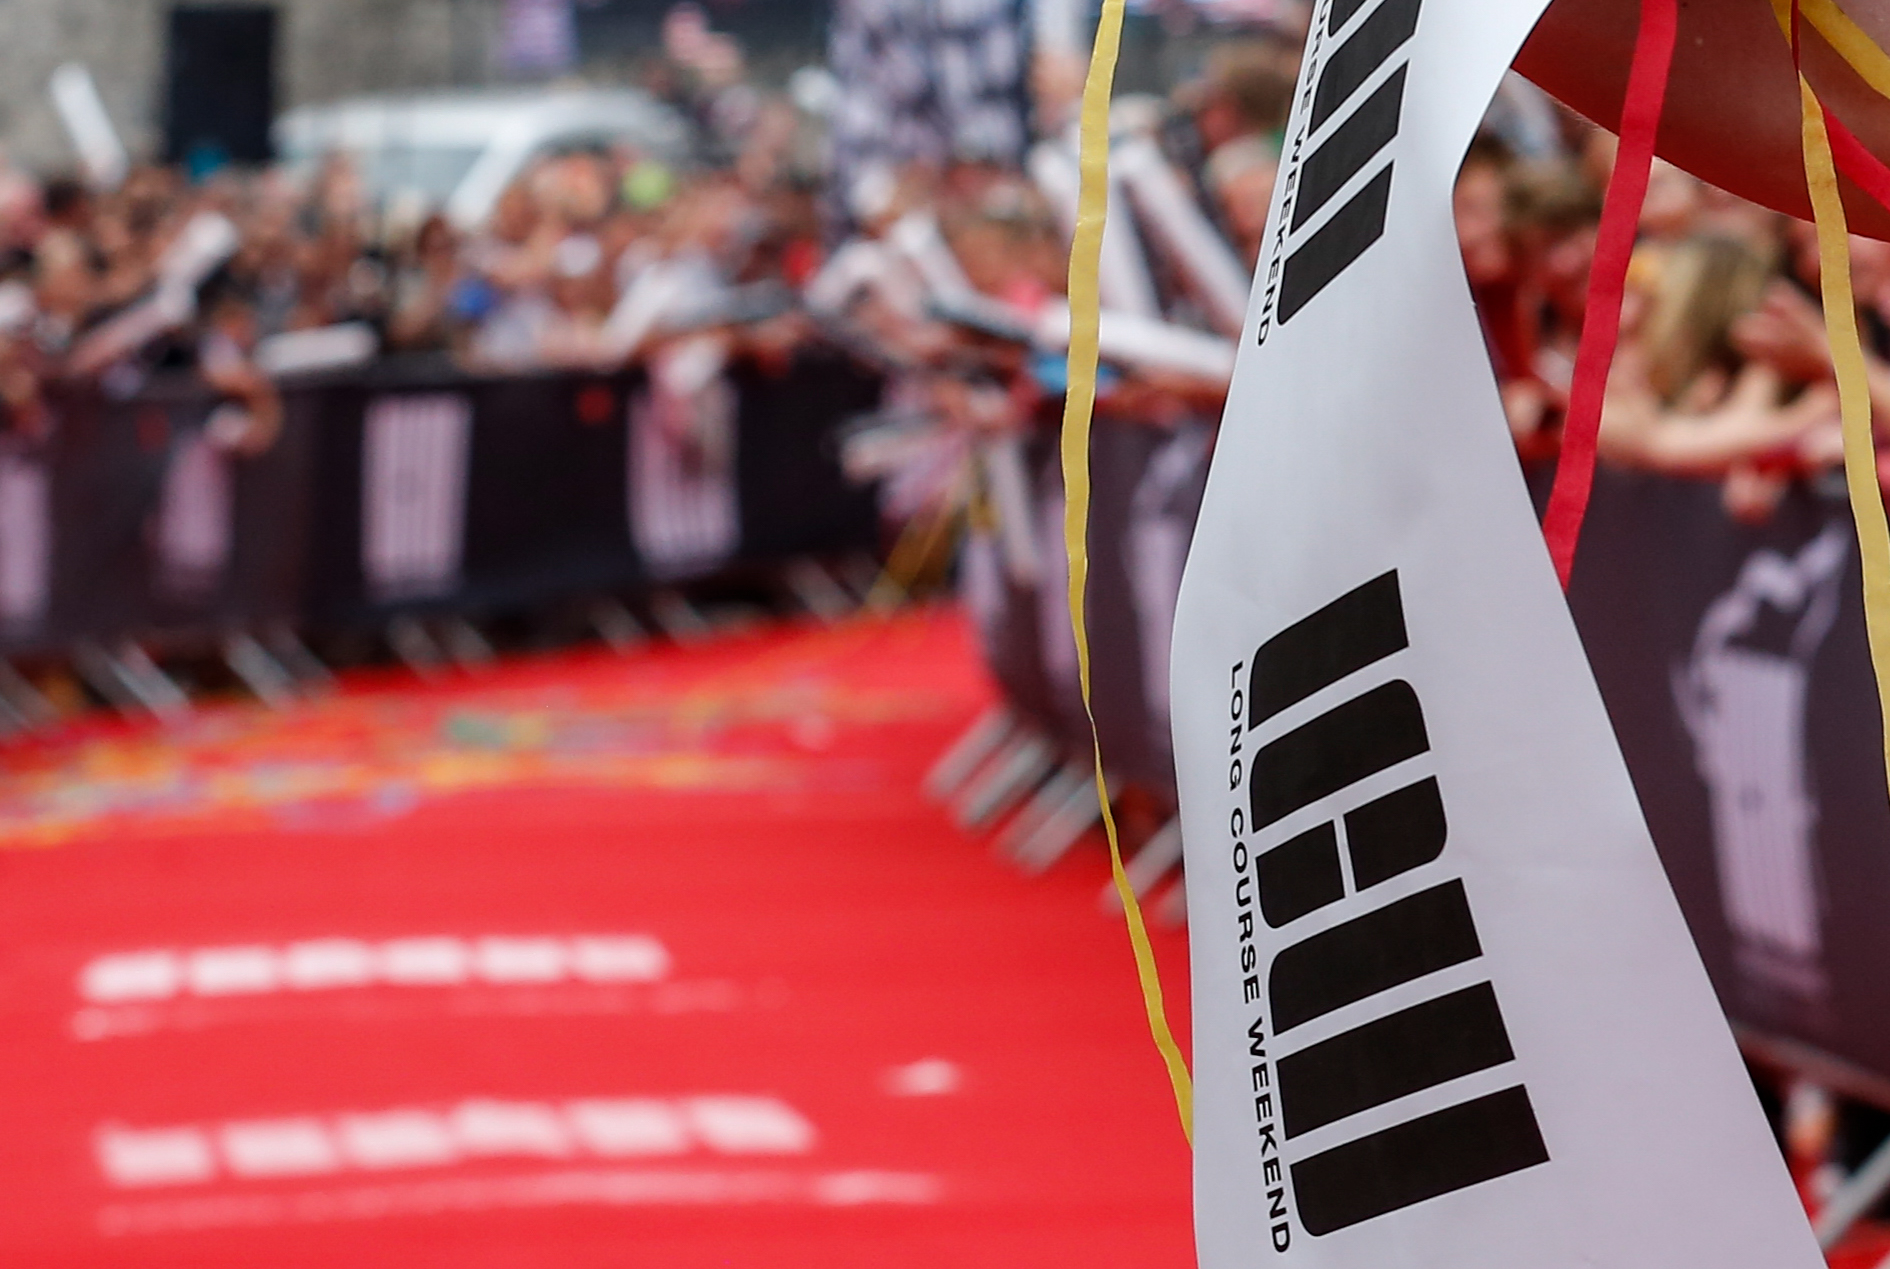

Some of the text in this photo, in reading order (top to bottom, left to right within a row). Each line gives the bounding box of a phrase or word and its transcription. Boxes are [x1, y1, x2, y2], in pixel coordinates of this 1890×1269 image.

[1258, 124, 1305, 346] WEEKEND
[1228, 661, 1290, 1254] LONG COURSE WEEKEND
